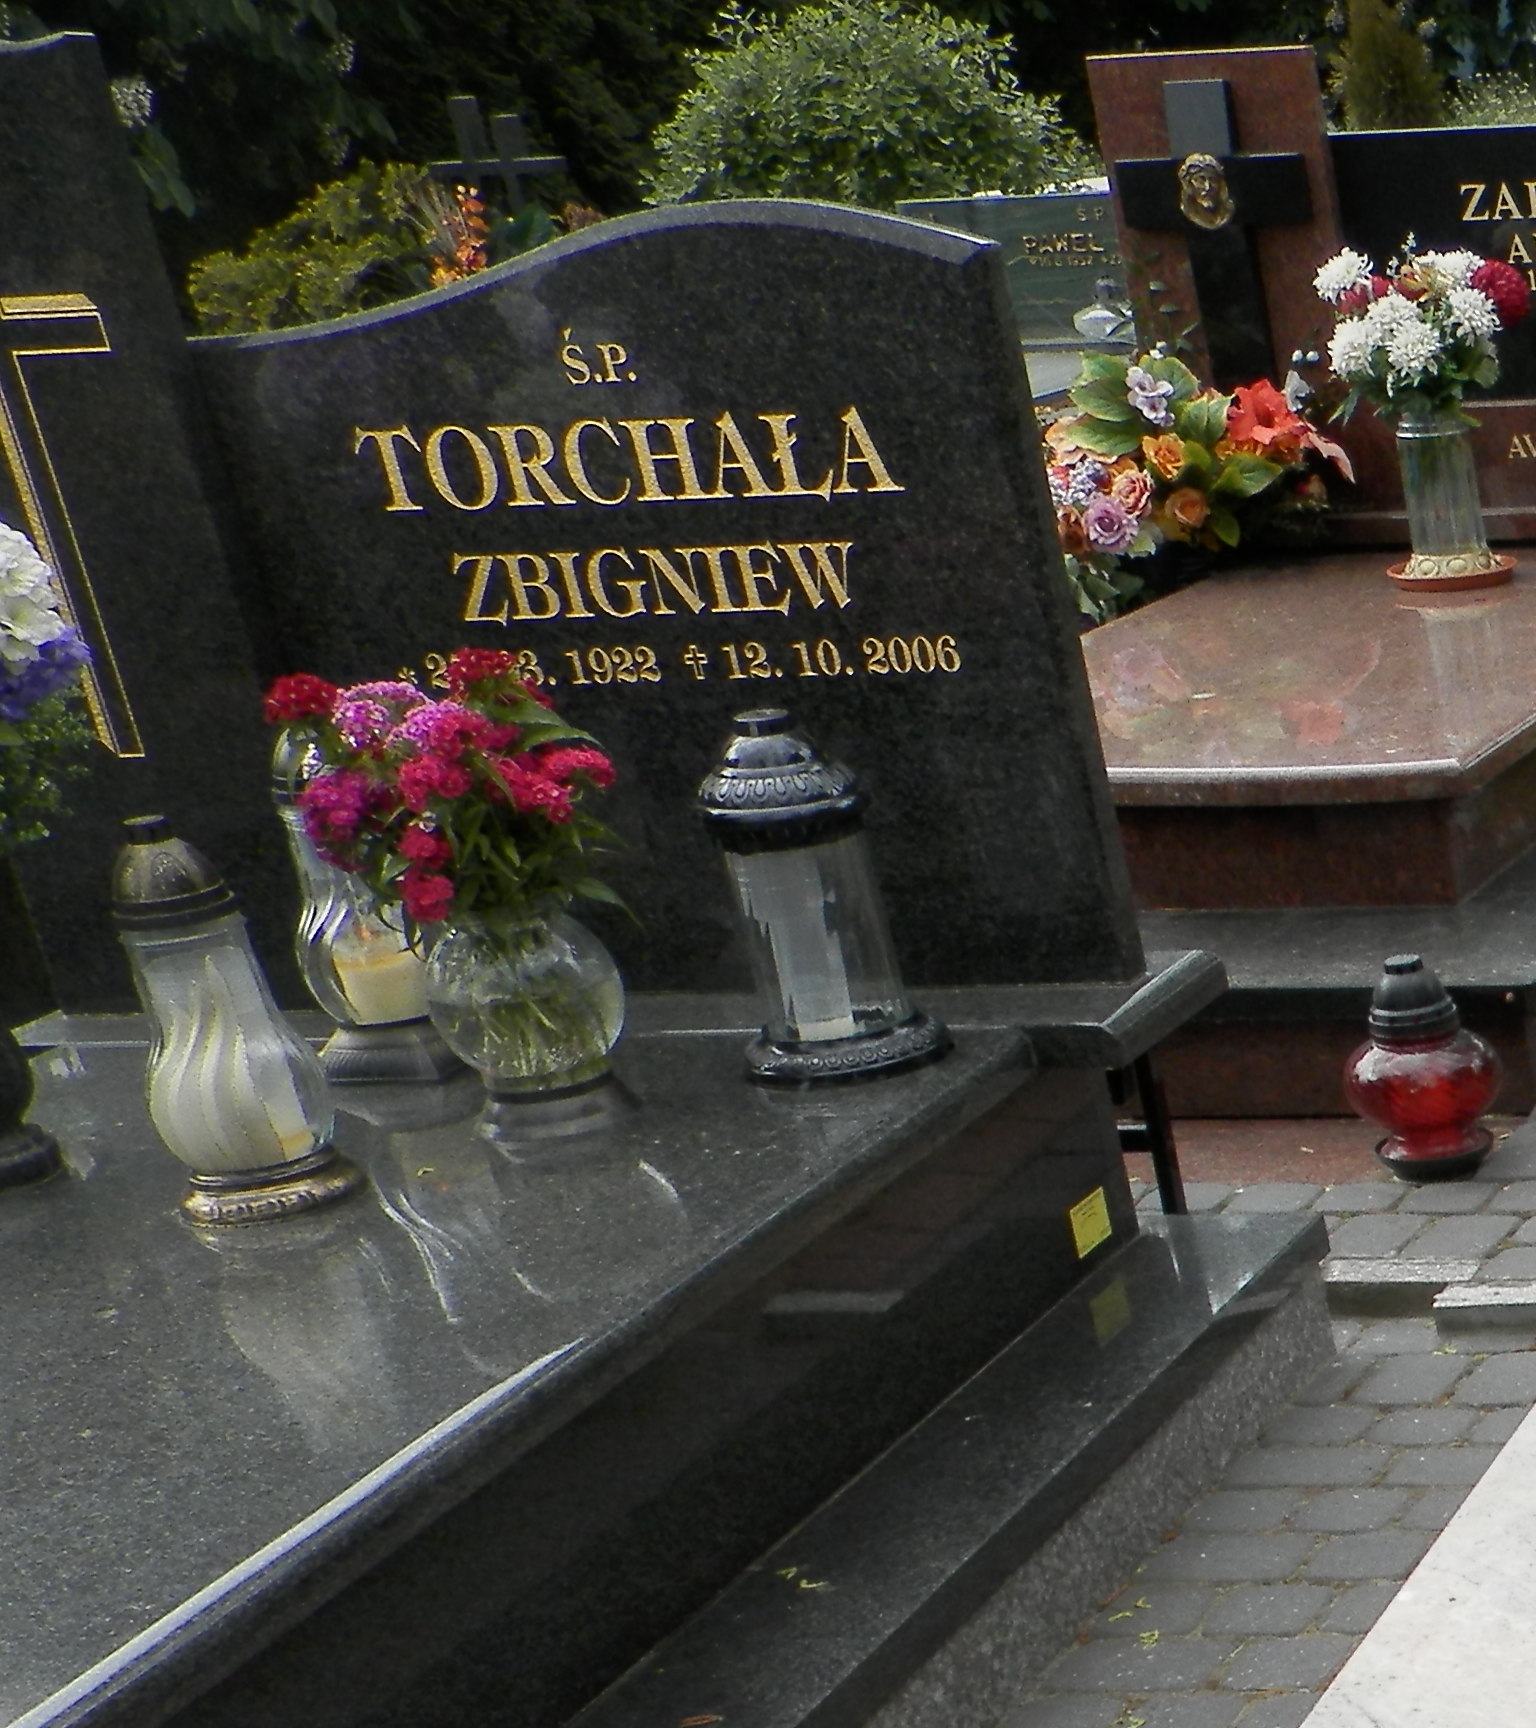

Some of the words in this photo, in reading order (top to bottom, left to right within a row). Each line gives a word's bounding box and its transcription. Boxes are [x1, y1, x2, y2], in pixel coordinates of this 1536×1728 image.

[354, 406, 906, 512] TORCHAŁA
[453, 540, 854, 627] ZBIGNIEW
[565, 645, 662, 685] 1922
[721, 641, 783, 680] 12.
[792, 638, 854, 677] 10.
[862, 634, 961, 675] 2006
